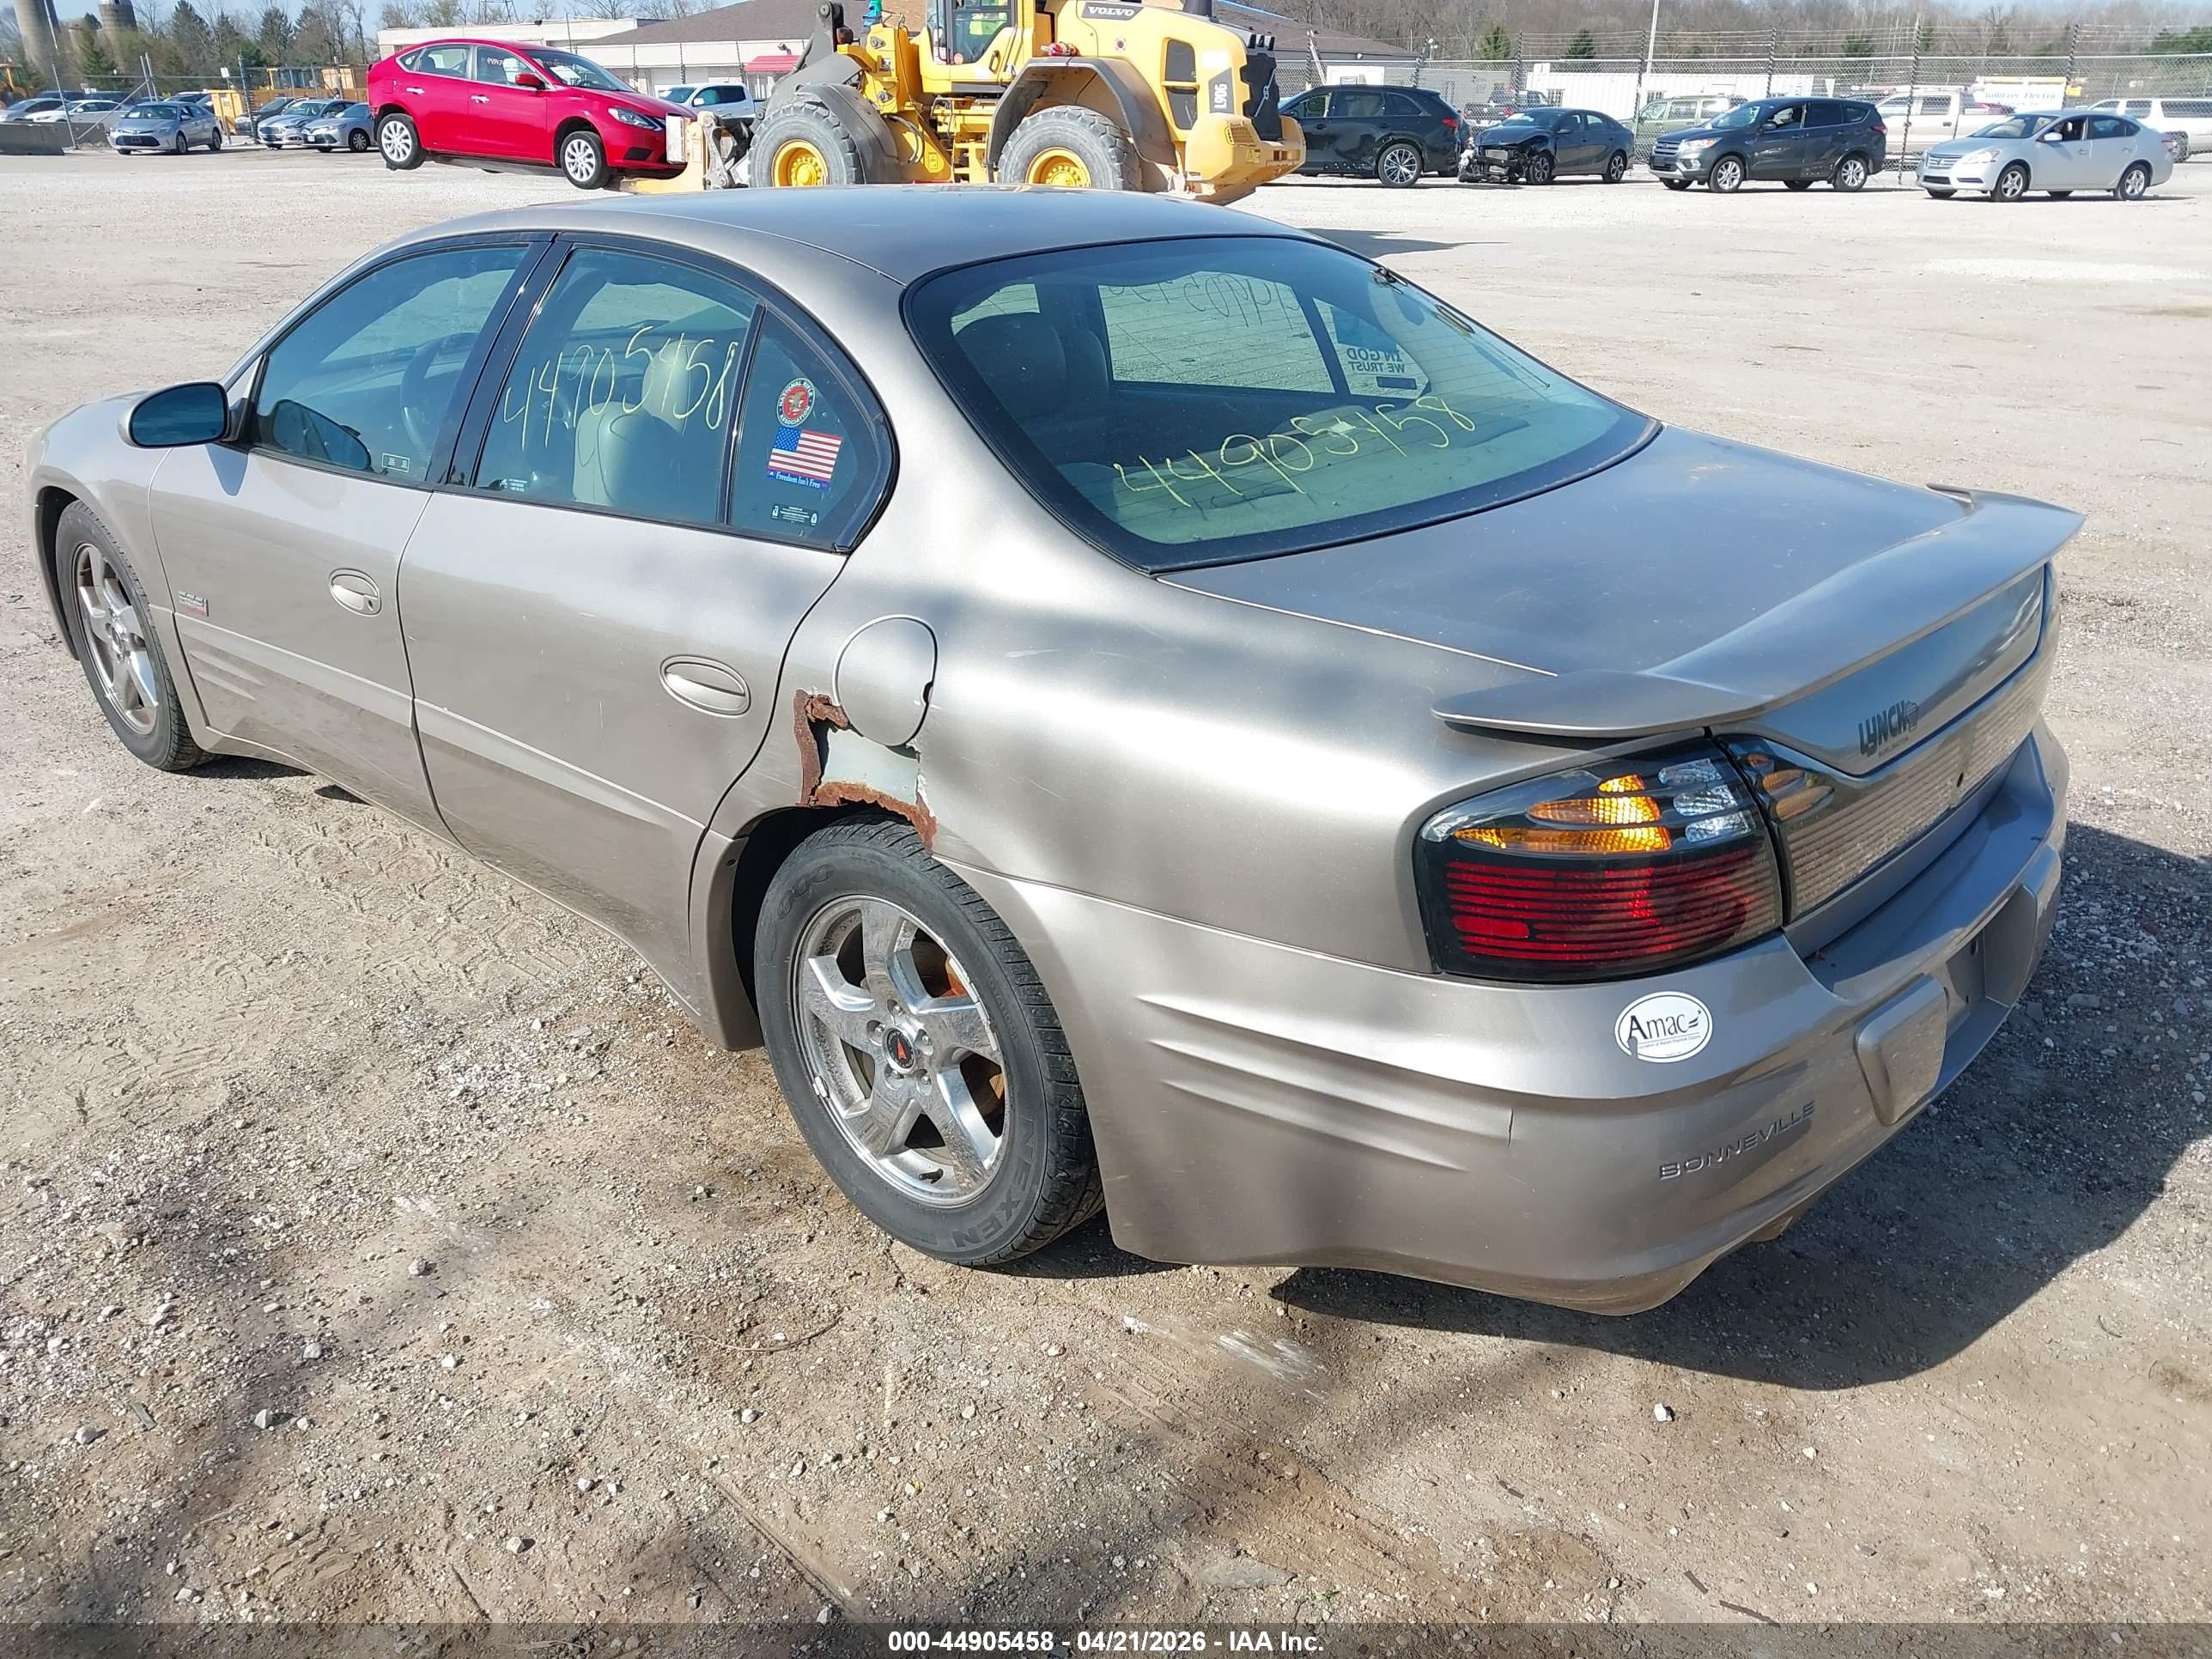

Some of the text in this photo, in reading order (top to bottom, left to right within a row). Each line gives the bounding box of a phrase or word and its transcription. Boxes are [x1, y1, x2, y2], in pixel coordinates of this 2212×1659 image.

[1087, 6, 1135, 16] VOLVO
[503, 325, 738, 452] 44905458
[778, 380, 813, 407] NATIONAL RIFLE
[779, 405, 811, 425] ASSOCIATION
[1113, 396, 1476, 507] 44905458
[775, 471, 798, 483] Freedom
[809, 479, 821, 489] Free
[1858, 700, 1908, 757] LYNCH
[1658, 1100, 1815, 1181] BONNEVILLE
